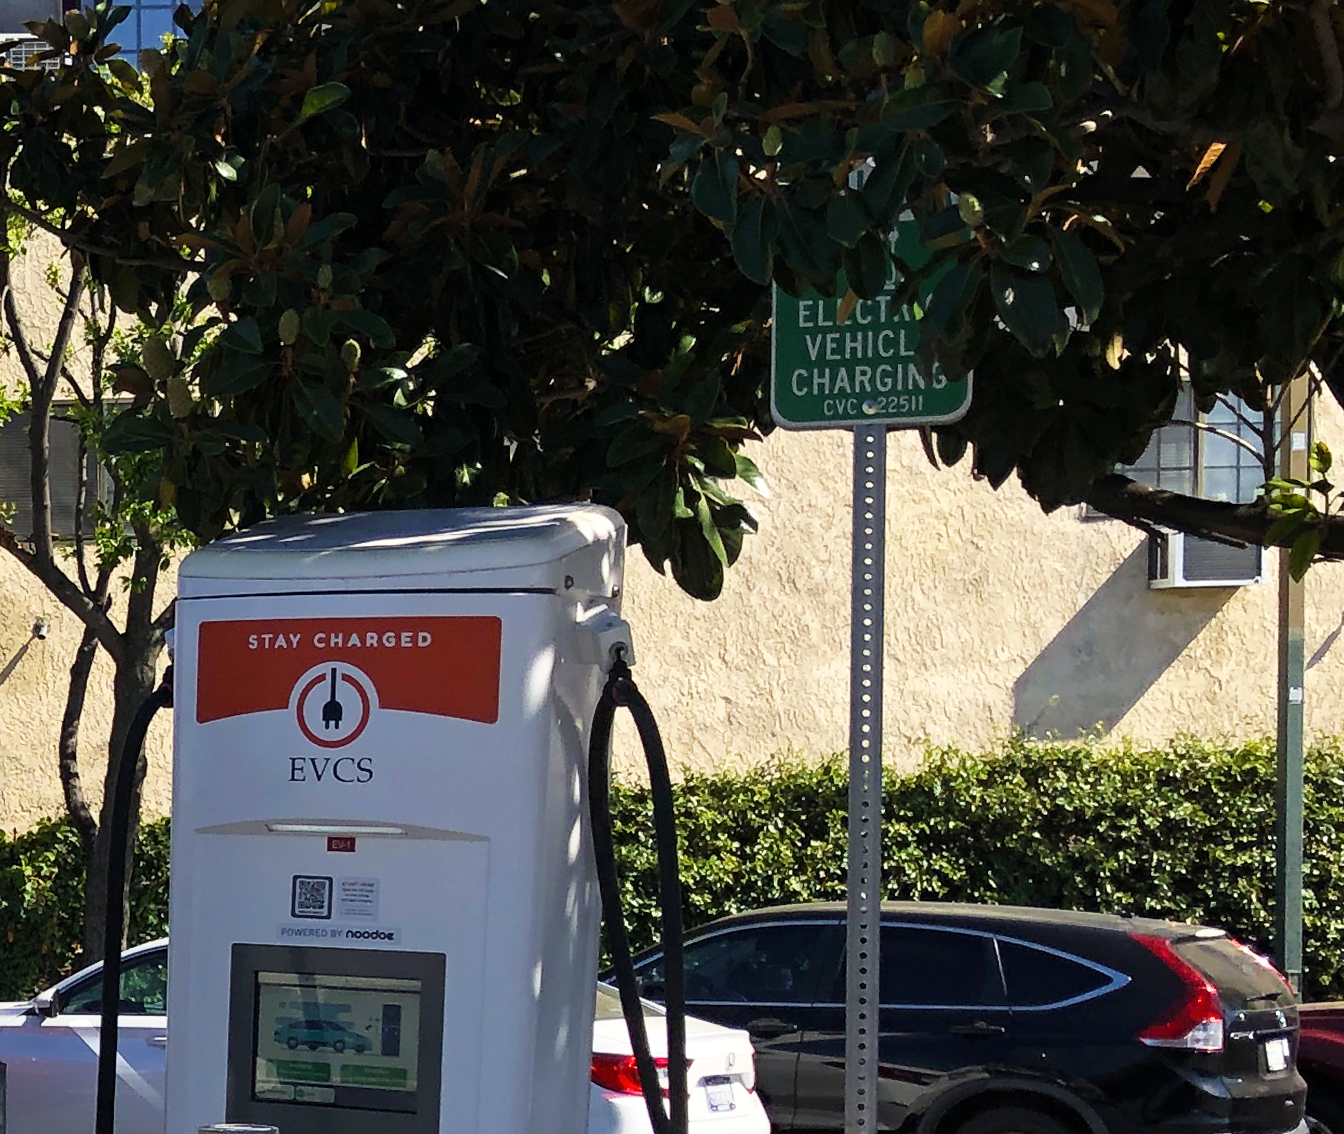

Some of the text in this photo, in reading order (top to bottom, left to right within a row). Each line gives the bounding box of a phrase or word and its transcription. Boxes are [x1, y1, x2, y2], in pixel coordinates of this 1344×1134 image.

[805, 329, 915, 361] VEHICL
[791, 362, 948, 397] CHARGING
[823, 395, 923, 416] CVC 22511
[247, 630, 433, 650] STAY CHARGED
[287, 756, 375, 784] EVCS
[280, 927, 395, 941] POWERED BY noodoe
